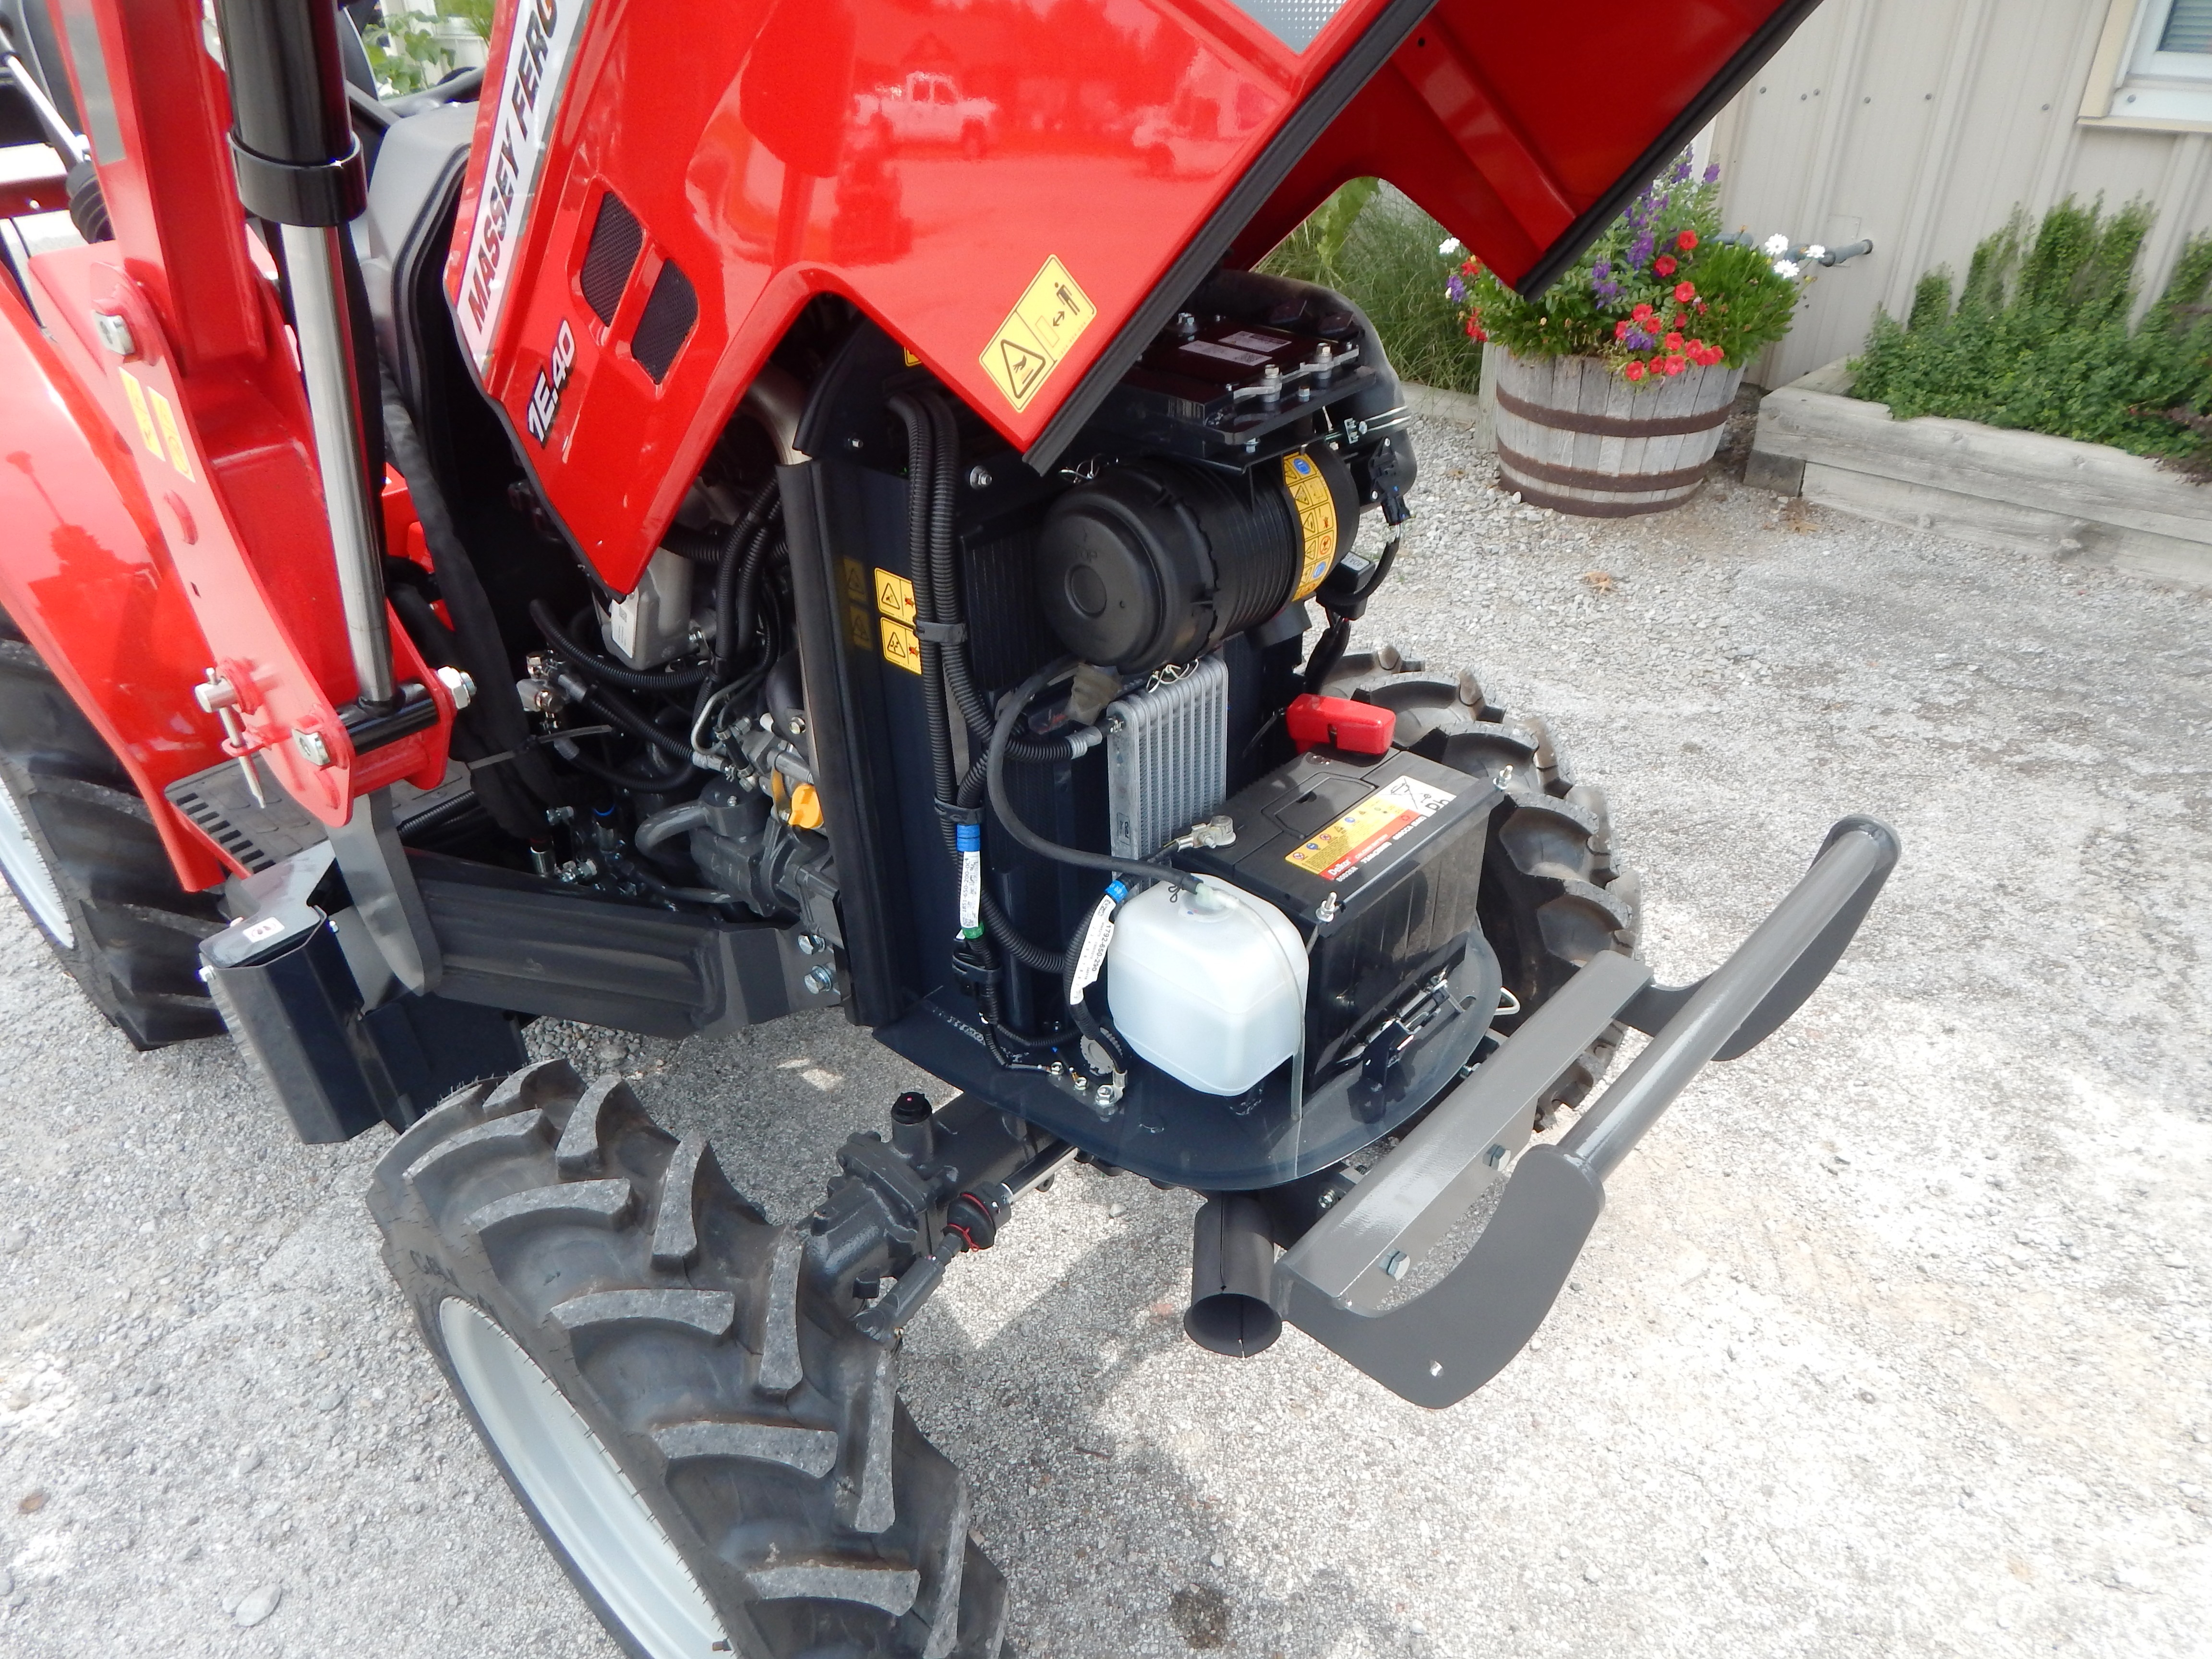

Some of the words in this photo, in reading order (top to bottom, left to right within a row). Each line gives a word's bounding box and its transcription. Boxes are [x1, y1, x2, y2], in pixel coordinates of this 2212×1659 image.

[468, 118, 519, 335] MASSEY
[528, 318, 577, 445] 1E.40
[1327, 859, 1351, 876] Delkor
[1092, 924, 1111, 972] 1792-650-290
